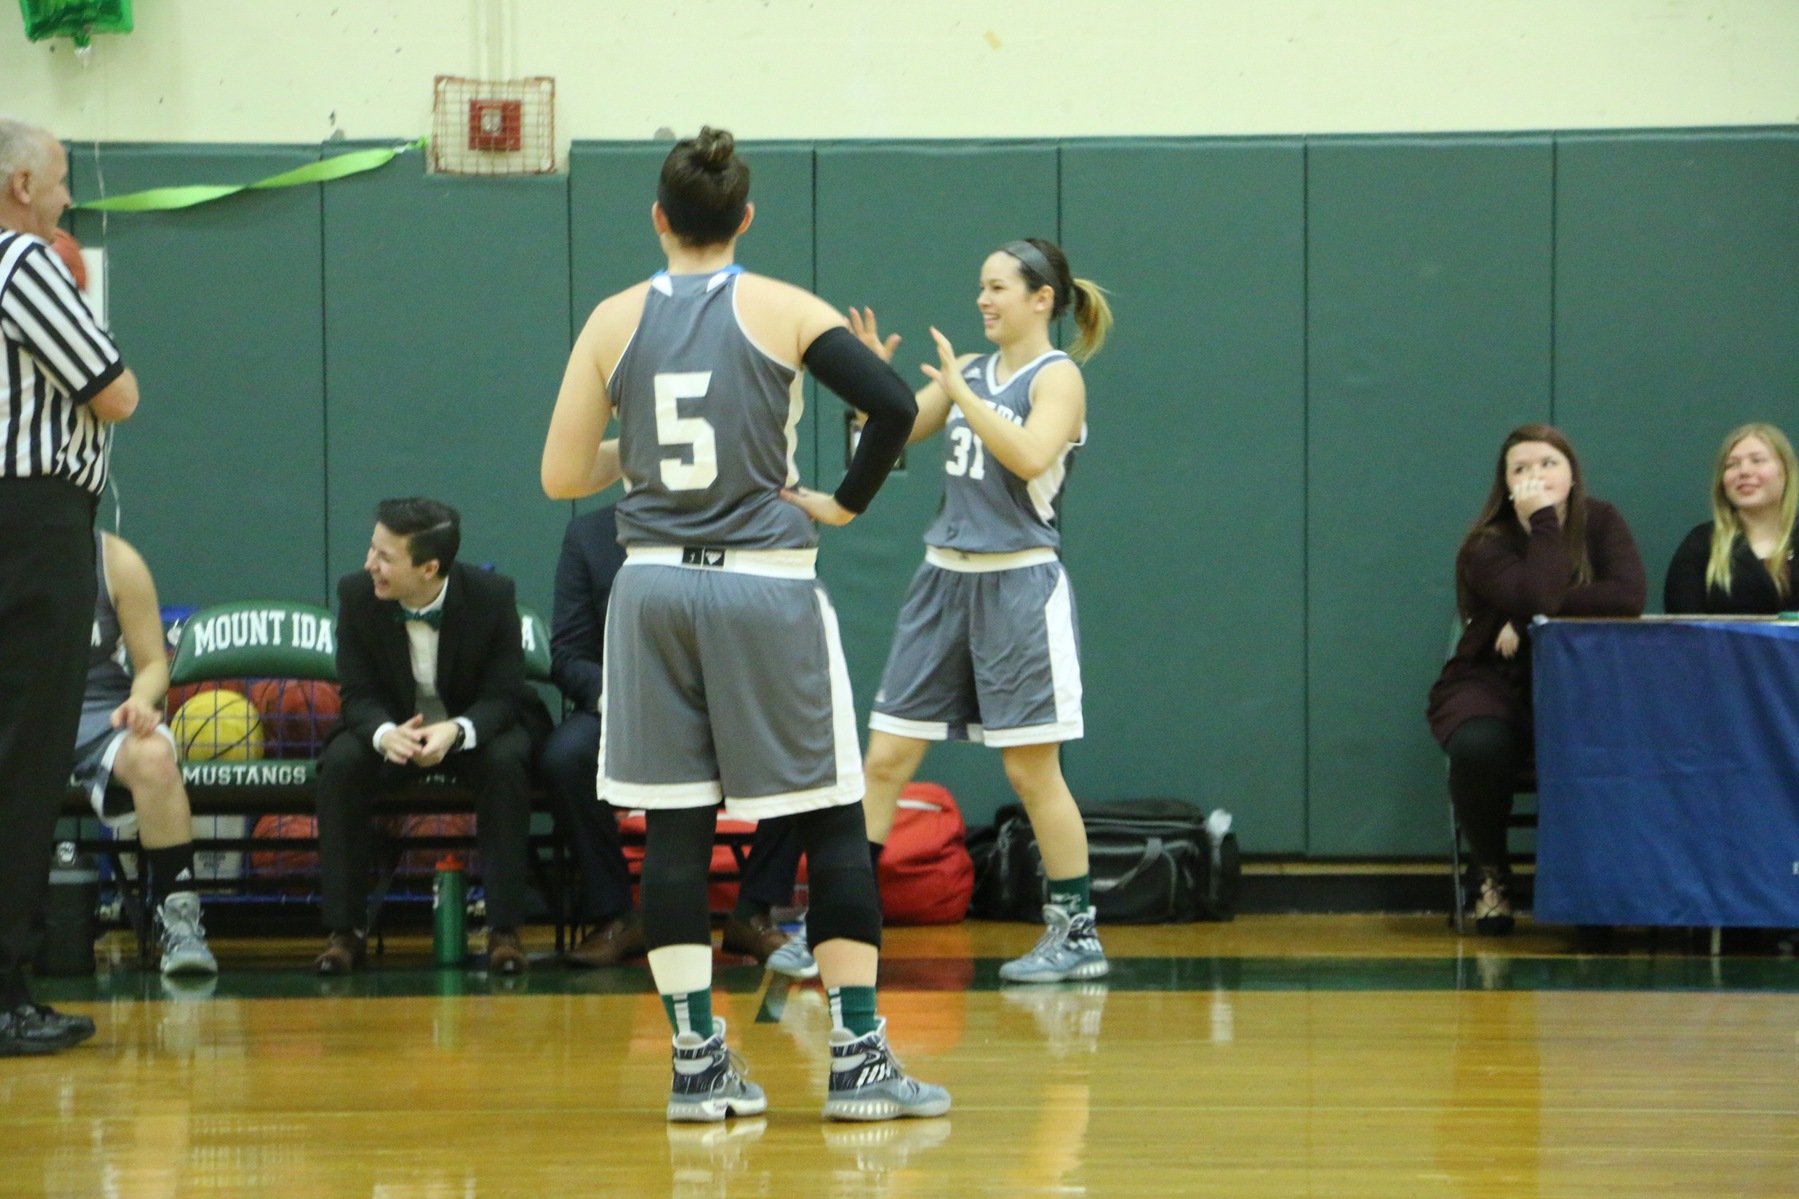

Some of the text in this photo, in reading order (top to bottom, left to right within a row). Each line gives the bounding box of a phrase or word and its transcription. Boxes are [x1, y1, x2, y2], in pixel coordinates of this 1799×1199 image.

[653, 371, 718, 491] 5
[945, 426, 985, 480] 31
[194, 610, 334, 658] MOUNT IDA
[183, 764, 306, 786] MUSTANGS
